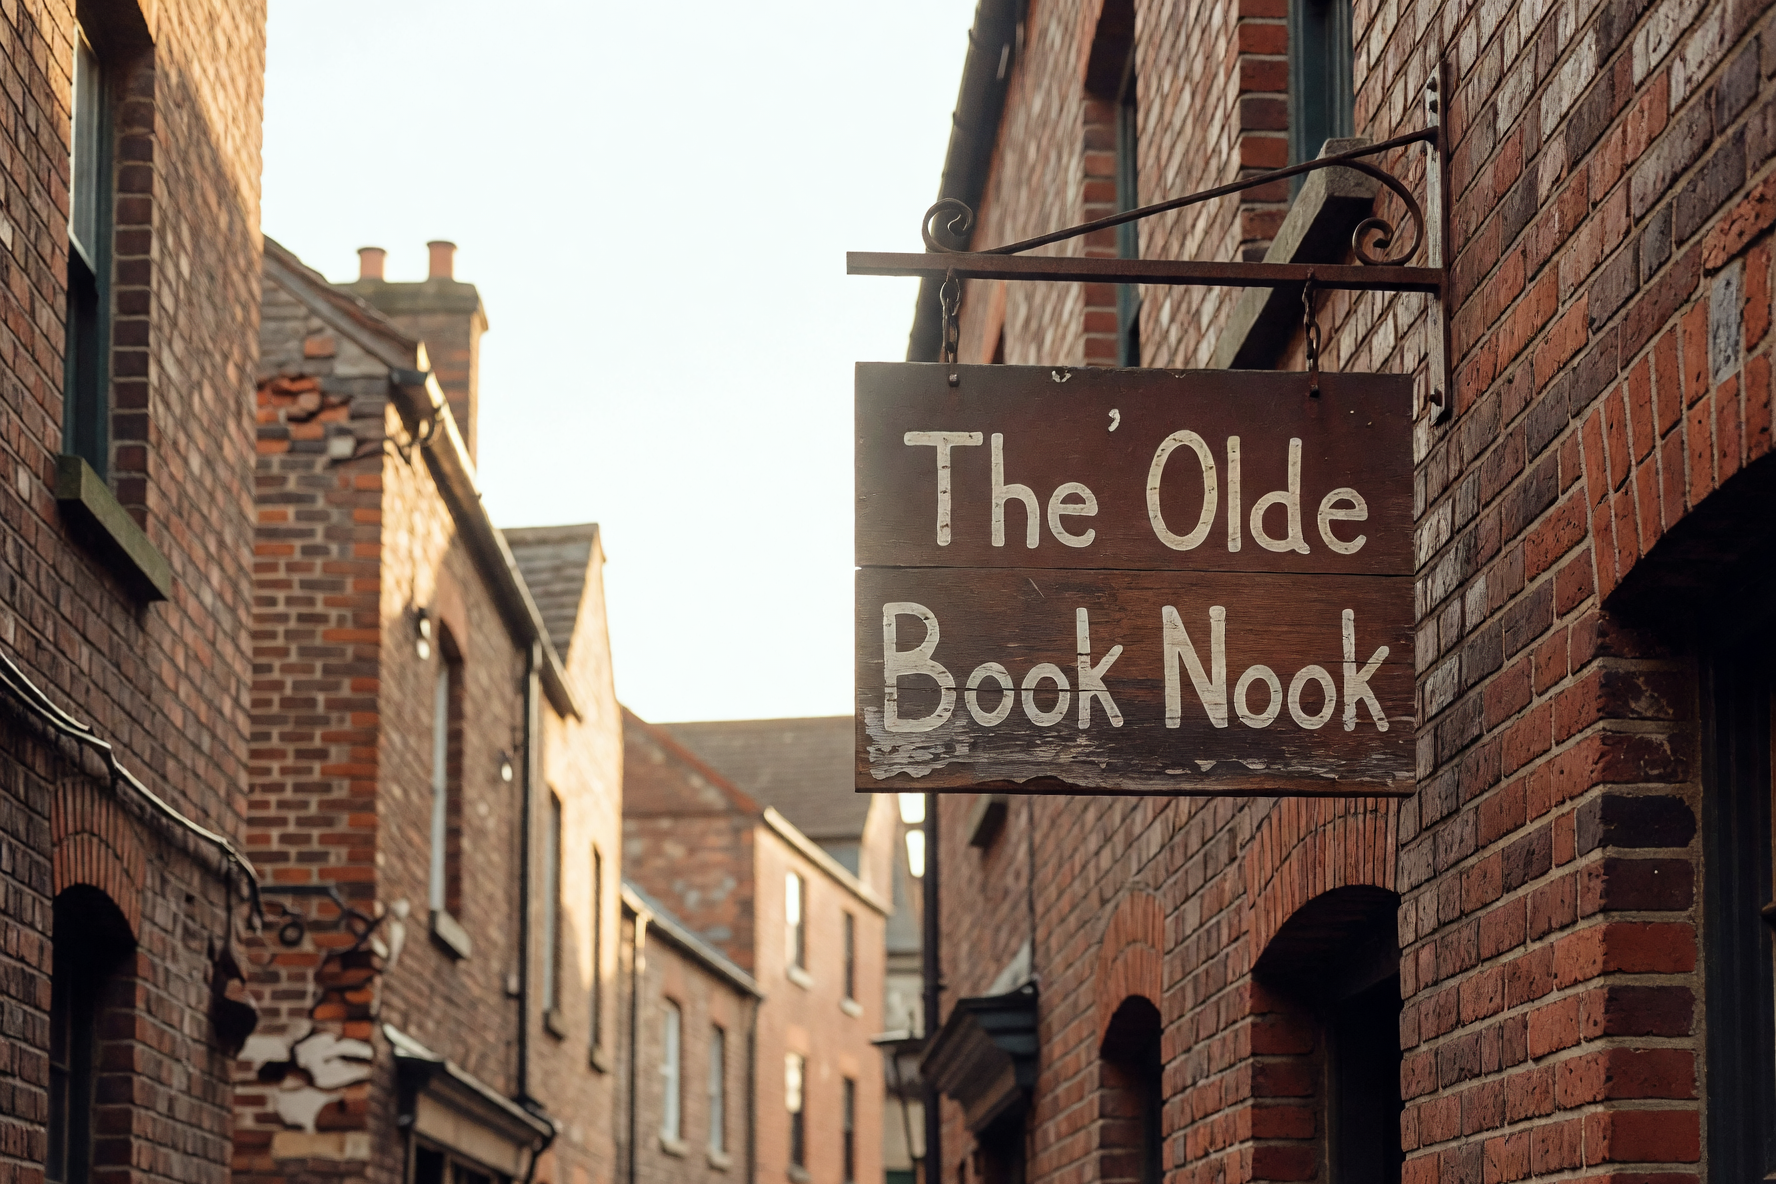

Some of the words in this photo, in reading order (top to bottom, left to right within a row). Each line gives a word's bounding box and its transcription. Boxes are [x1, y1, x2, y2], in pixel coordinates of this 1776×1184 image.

[903, 430, 1099, 549] The
[882, 601, 1124, 733] Book
[1161, 604, 1390, 732] Nook
